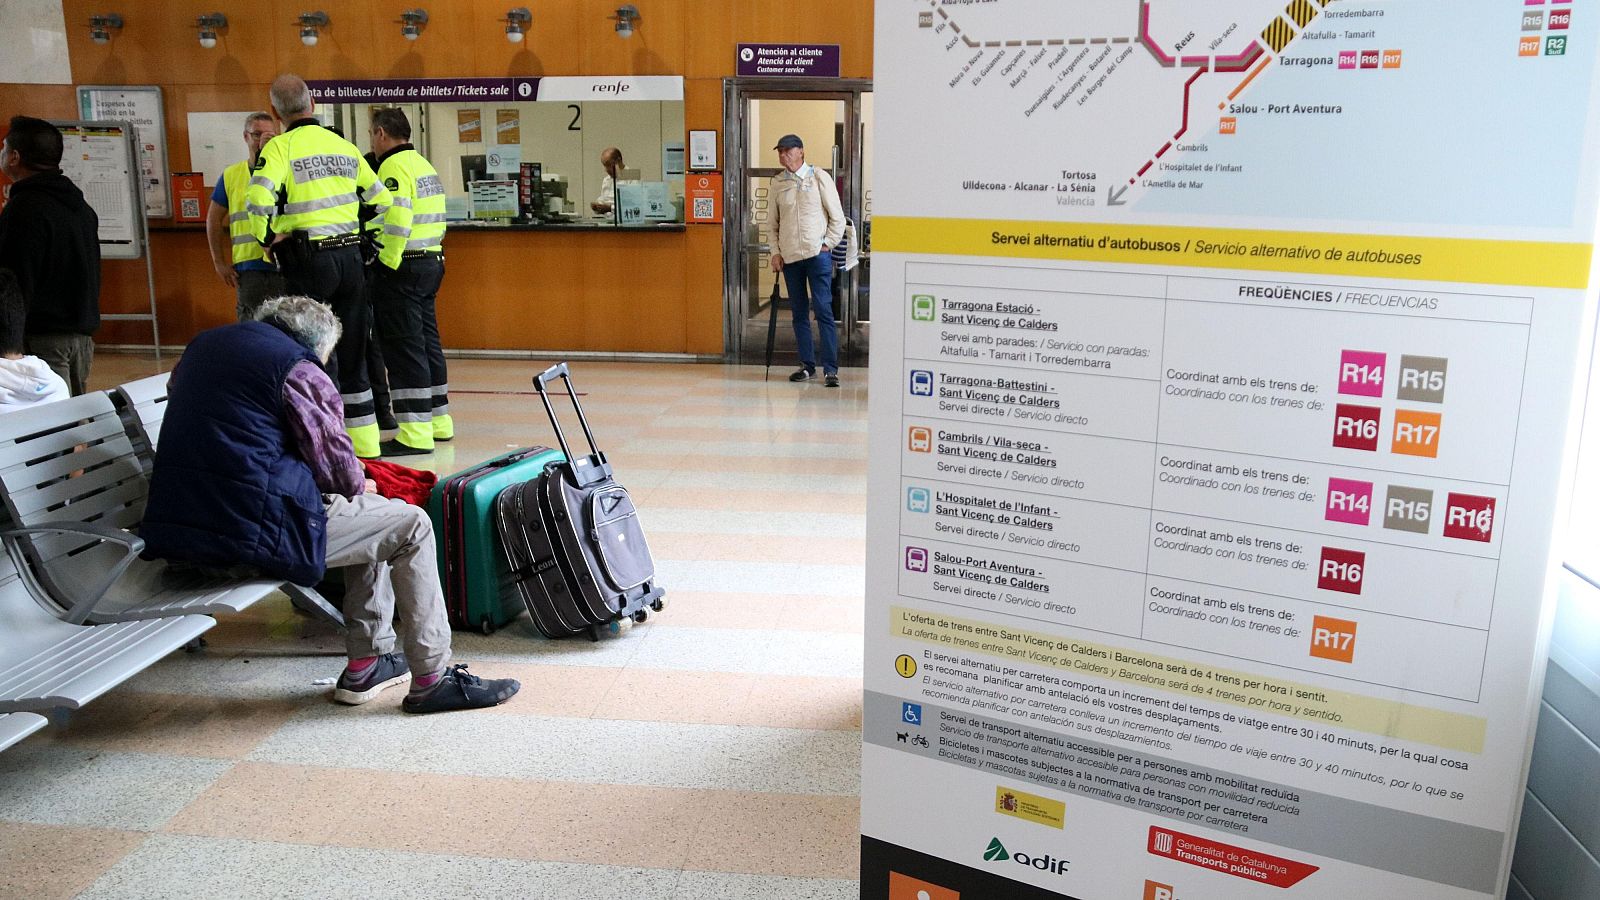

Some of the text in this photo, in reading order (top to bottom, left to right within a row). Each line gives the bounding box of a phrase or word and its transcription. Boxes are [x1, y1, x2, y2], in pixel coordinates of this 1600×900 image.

[1323, 8, 1384, 18] Torredembarra
[1524, 15, 1569, 25] R15 R16
[934, 22, 946, 34] Flix
[1208, 22, 1237, 50] Vila-seca
[1301, 29, 1375, 40] Altafulla Tamarit
[757, 47, 822, 55] Atención al cliente
[1174, 30, 1194, 51] Reus
[1521, 39, 1564, 51] R17 R2
[785, 57, 792, 65] al
[793, 57, 813, 65] client
[971, 49, 1005, 86] Els Guiamets
[1000, 48, 1026, 76] Capçanes
[1009, 47, 1047, 88] Marçà Falset
[1047, 45, 1068, 70] Pradell
[1056, 46, 1089, 81] L'Argentera
[1279, 55, 1400, 67] Tarragona R14 R16 R17
[1052, 44, 1112, 110] Riudecanyes Botarell
[1076, 45, 1133, 106] Les Borges del Camp
[308, 88, 322, 97] nta
[324, 86, 335, 97] de
[407, 86, 418, 96] de
[490, 85, 509, 95] sale
[592, 80, 629, 95] renfe
[568, 105, 581, 130] 2
[1229, 103, 1341, 113] Salou Port Aventura
[1220, 122, 1235, 130] R17
[1175, 143, 1208, 152] Cambrils
[294, 156, 358, 172] SEGURIDAD
[308, 166, 352, 178] PROSEGUR
[1062, 170, 1096, 179] Tortosa
[1159, 162, 1242, 172] L'Hospitalet de l'Infant
[962, 180, 1006, 190] Ulldecona
[1013, 181, 1048, 191] Alcanar
[1056, 182, 1067, 192] La
[1142, 179, 1203, 188] L'Ametlla de Mar
[1056, 194, 1095, 206] València
[991, 231, 1421, 264] Servei alternatiu d'autobusos Servicio alternativo de autobuses
[941, 298, 1033, 314] Tarragona Estació
[1238, 285, 1438, 309] FREQÜÈNCIES FRECUENCIAS
[941, 312, 1058, 330] Sant Vicenç de Calders
[939, 345, 978, 357] Altafulla
[988, 348, 1026, 361] Tamarit
[1034, 352, 1111, 368] Torredembarra
[939, 372, 1047, 393] Tarragona-Battestini
[1166, 368, 1318, 393] Coordinat amb els trens de:
[1342, 363, 1443, 390] R14 R15
[938, 386, 1060, 408] Sant Vicenç de Calders
[937, 430, 1040, 450] Cambrils Vila-seca
[1337, 417, 1438, 444] R16 R17
[937, 443, 1056, 466] Sant Vicenç de Calders
[936, 491, 1050, 515] L'Hospitalet de l'Infant
[1330, 491, 1368, 512] R14
[1388, 498, 1428, 521] R15
[935, 504, 1053, 529] Sant Vicenç de Calders
[933, 551, 1034, 575] Salou-Port Aventura
[1322, 560, 1360, 582] R16
[933, 564, 1049, 591] Sant Vicenç de Calders
[1314, 628, 1353, 650] R17
[923, 663, 1221, 732] es recomana planificar amb antelació els vostres desplaçaments.
[1013, 852, 1070, 875] adif
[1175, 847, 1267, 879] Transports públics
[1176, 838, 1286, 874] Generalitat de Catalunya
